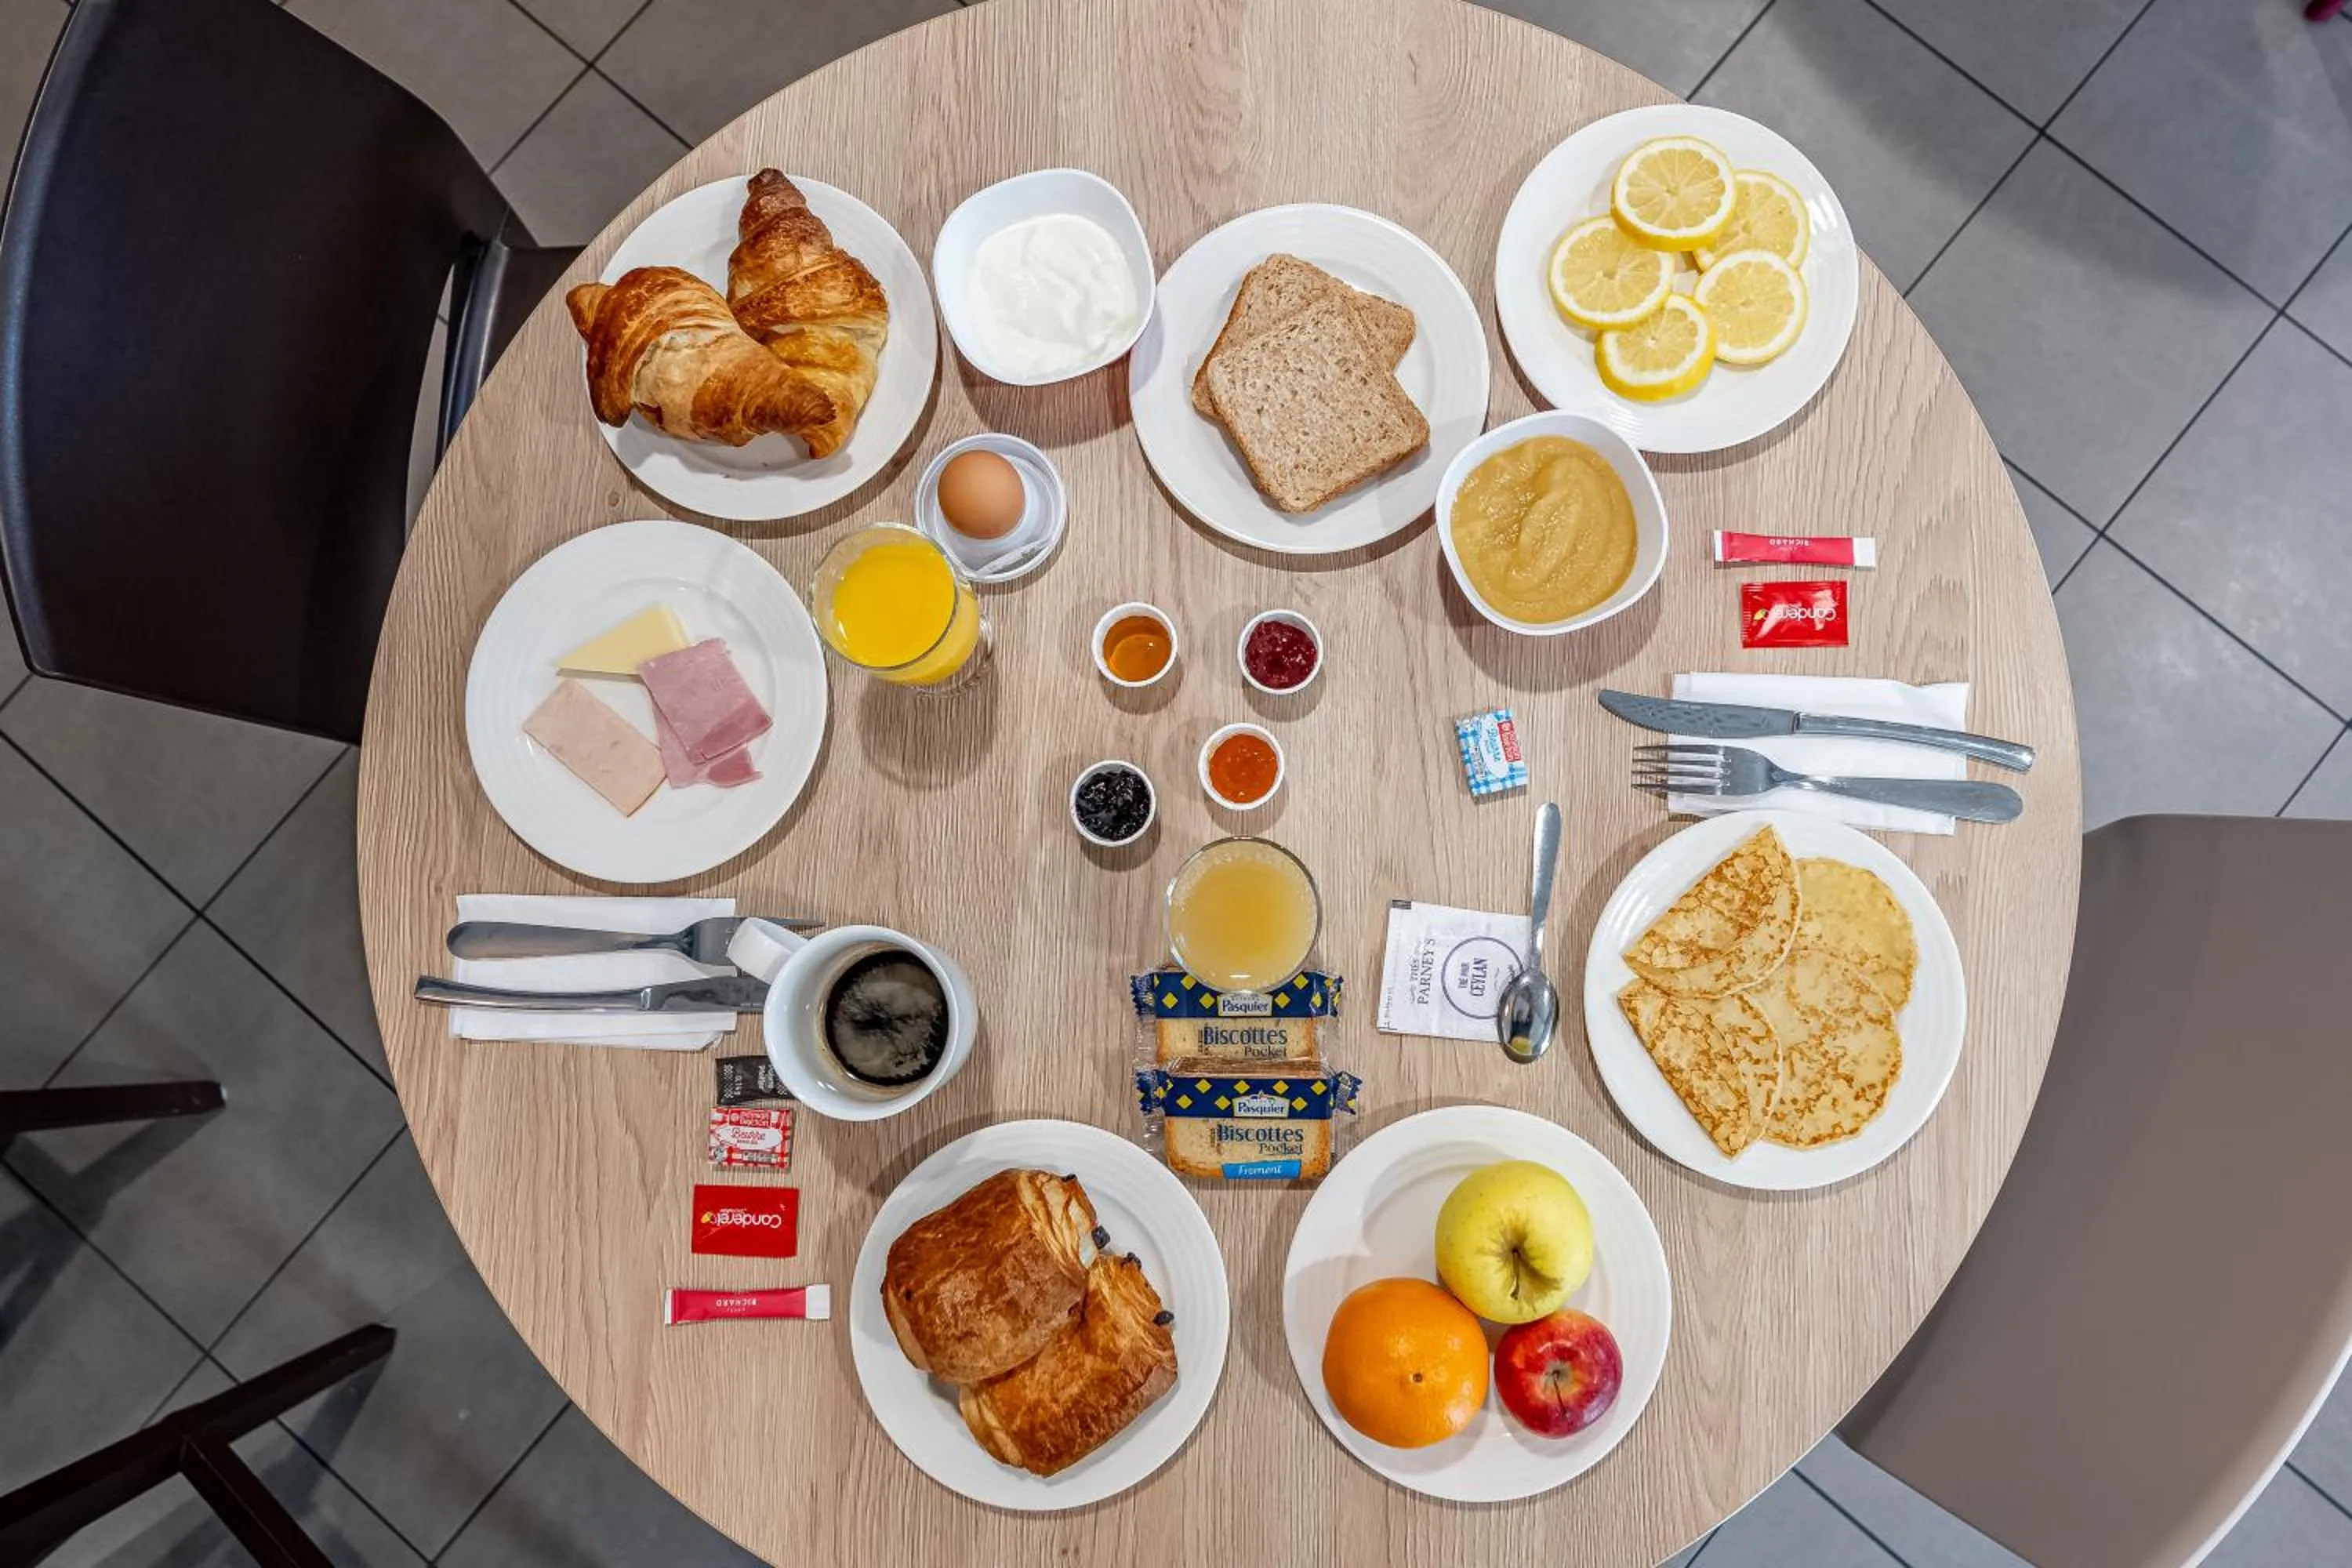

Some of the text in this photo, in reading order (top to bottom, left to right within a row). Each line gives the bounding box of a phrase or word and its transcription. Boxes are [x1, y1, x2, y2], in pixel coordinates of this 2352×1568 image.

[1773, 607, 1837, 621] Candere
[1469, 957, 1488, 997] CEYLAN
[1222, 1000, 1269, 1014] Pasquier
[1203, 1026, 1288, 1045] Biscottes
[1243, 1045, 1287, 1058] Pocket
[1238, 1102, 1284, 1115] Pasquier
[1217, 1124, 1304, 1143] Biscottes
[1258, 1142, 1303, 1155] Pocket
[1237, 1163, 1282, 1176] Froment
[717, 1213, 782, 1229] Canderel
[716, 1298, 757, 1307] RICHARD
